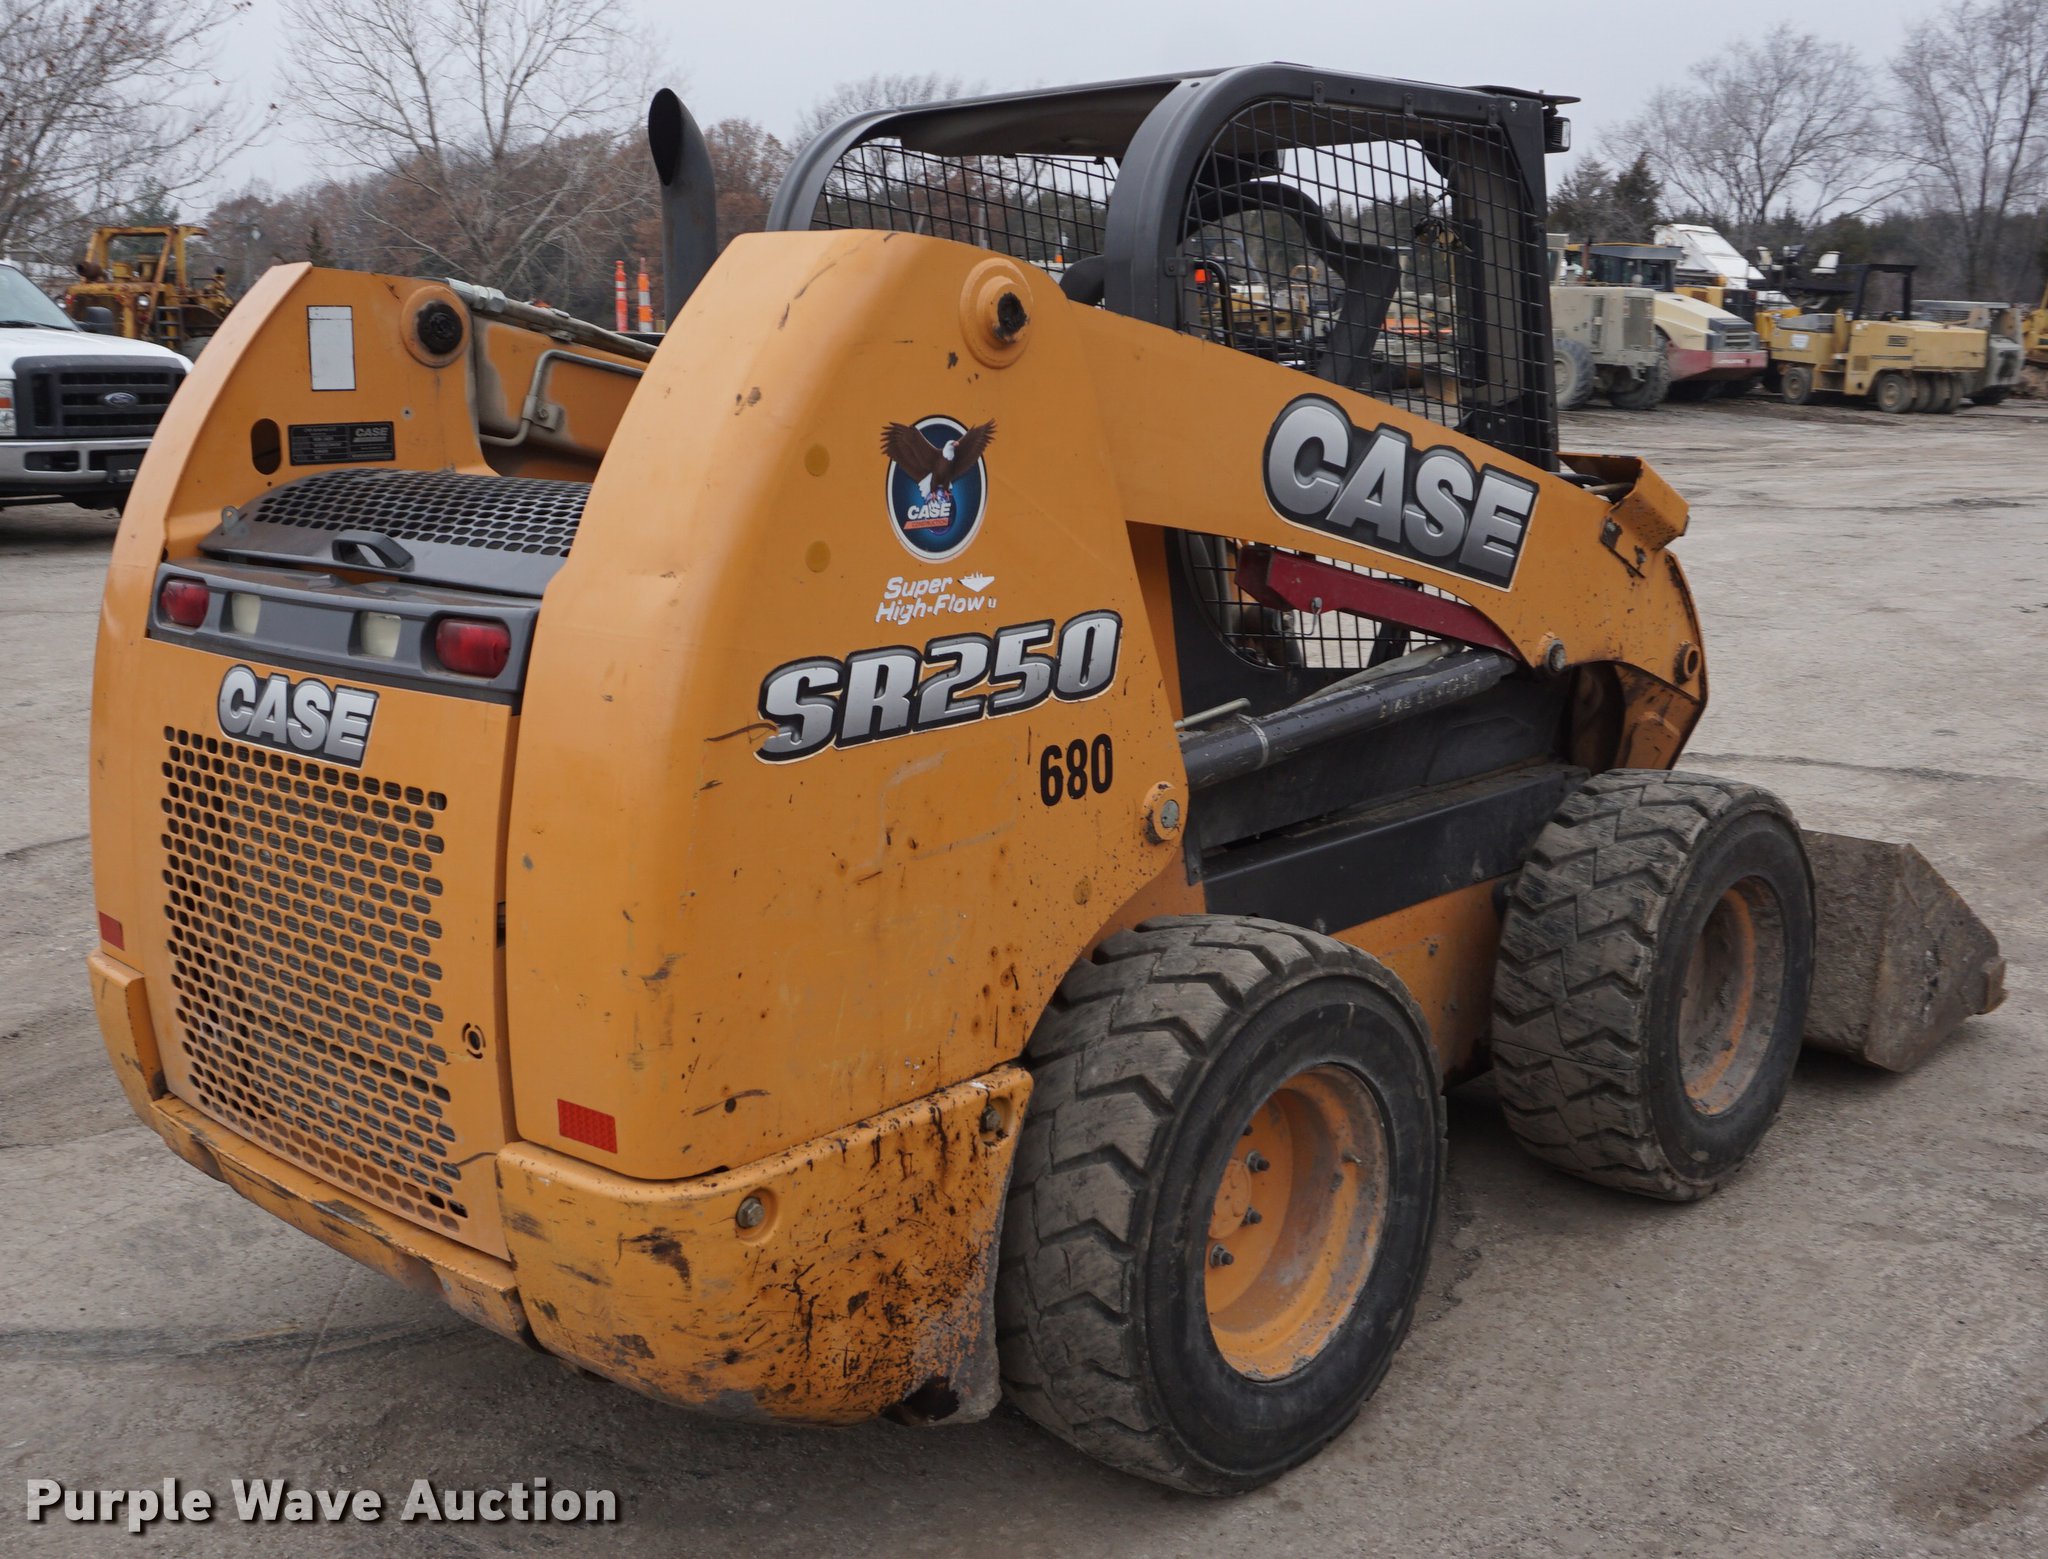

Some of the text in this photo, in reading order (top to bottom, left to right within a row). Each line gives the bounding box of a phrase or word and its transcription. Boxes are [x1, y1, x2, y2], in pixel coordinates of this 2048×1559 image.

[355, 427, 389, 437] CASE
[907, 502, 951, 520] CASE
[1265, 395, 1537, 582] CASE
[875, 594, 985, 625] High-Flow
[884, 576, 953, 599] Super
[757, 612, 1121, 760] SR250
[218, 665, 378, 763] CASE
[1040, 733, 1113, 807] 680
